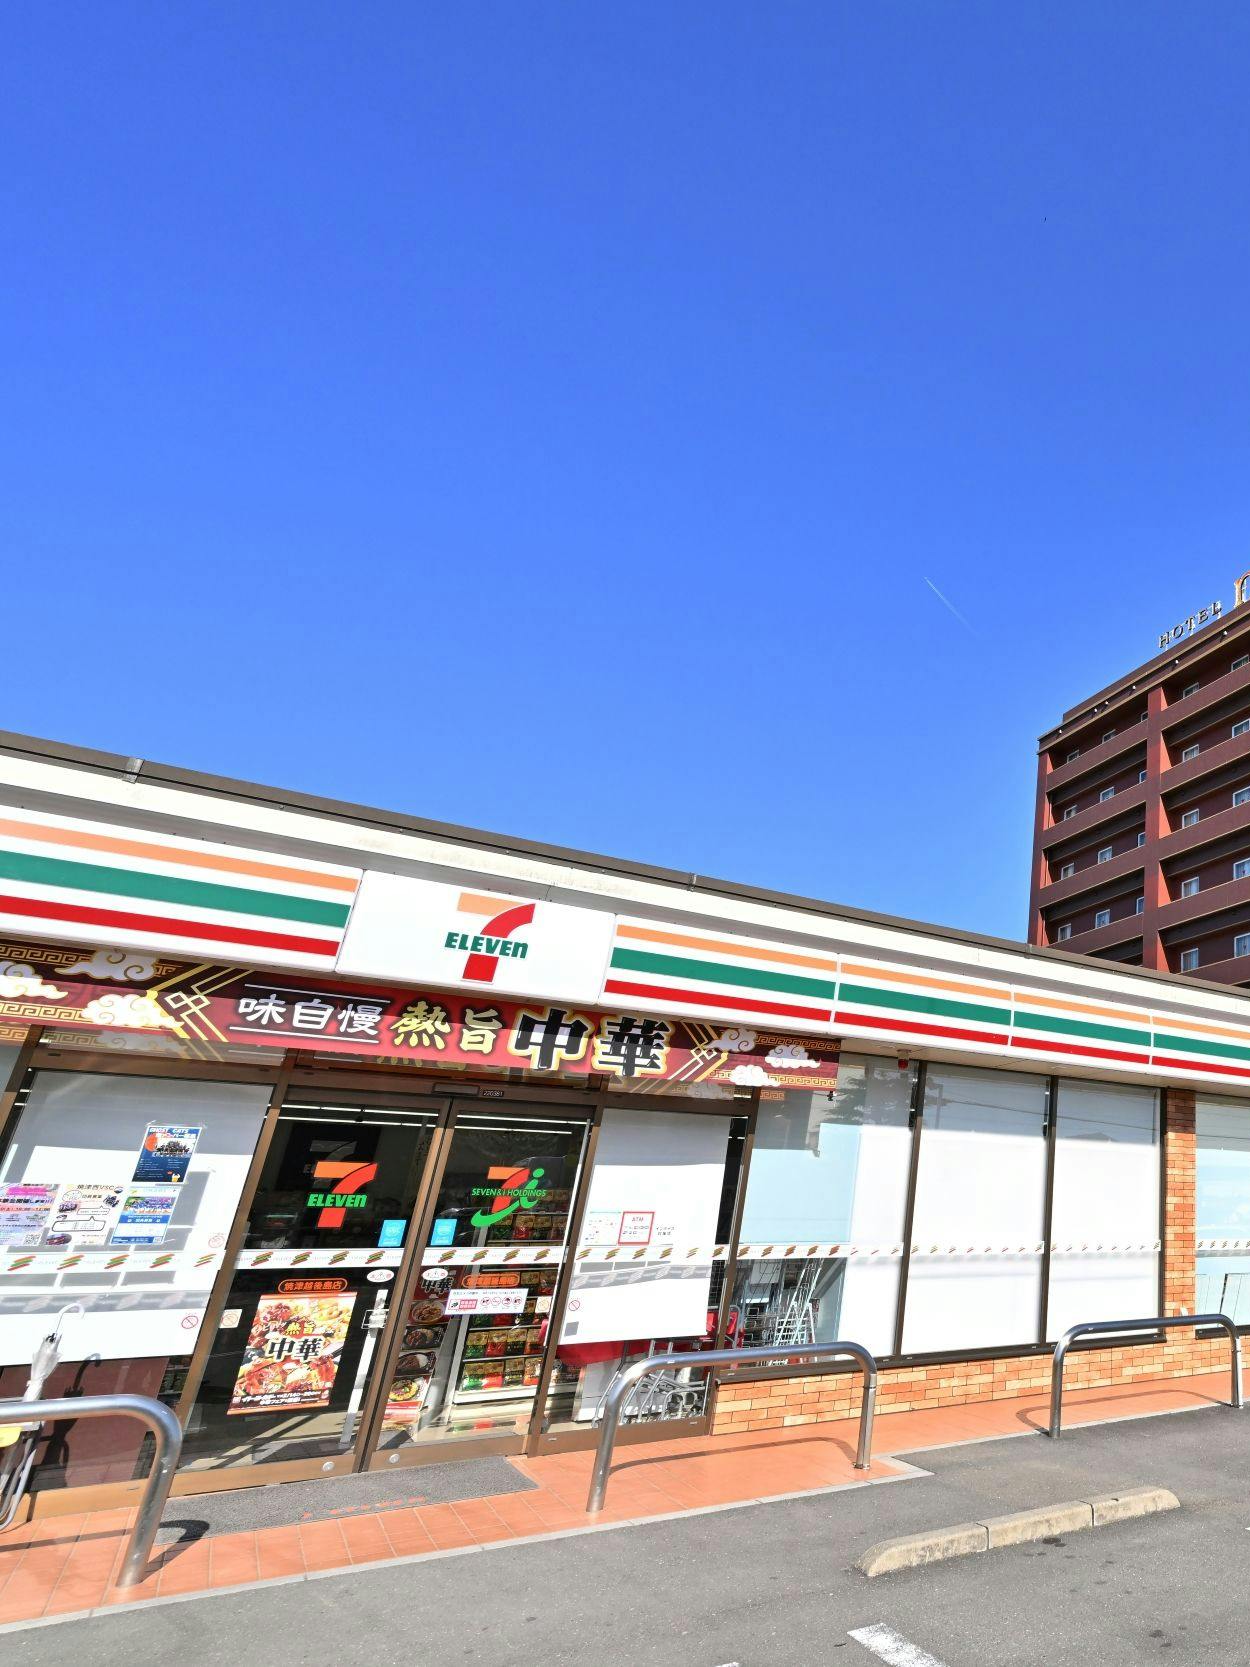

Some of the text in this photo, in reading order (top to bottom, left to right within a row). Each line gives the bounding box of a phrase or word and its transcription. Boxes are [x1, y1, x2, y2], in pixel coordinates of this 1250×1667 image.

[1159, 600, 1223, 648] HOTEL
[456, 891, 536, 984] 7
[237, 993, 383, 1037] 味自慢
[268, 1336, 324, 1361] 中華
